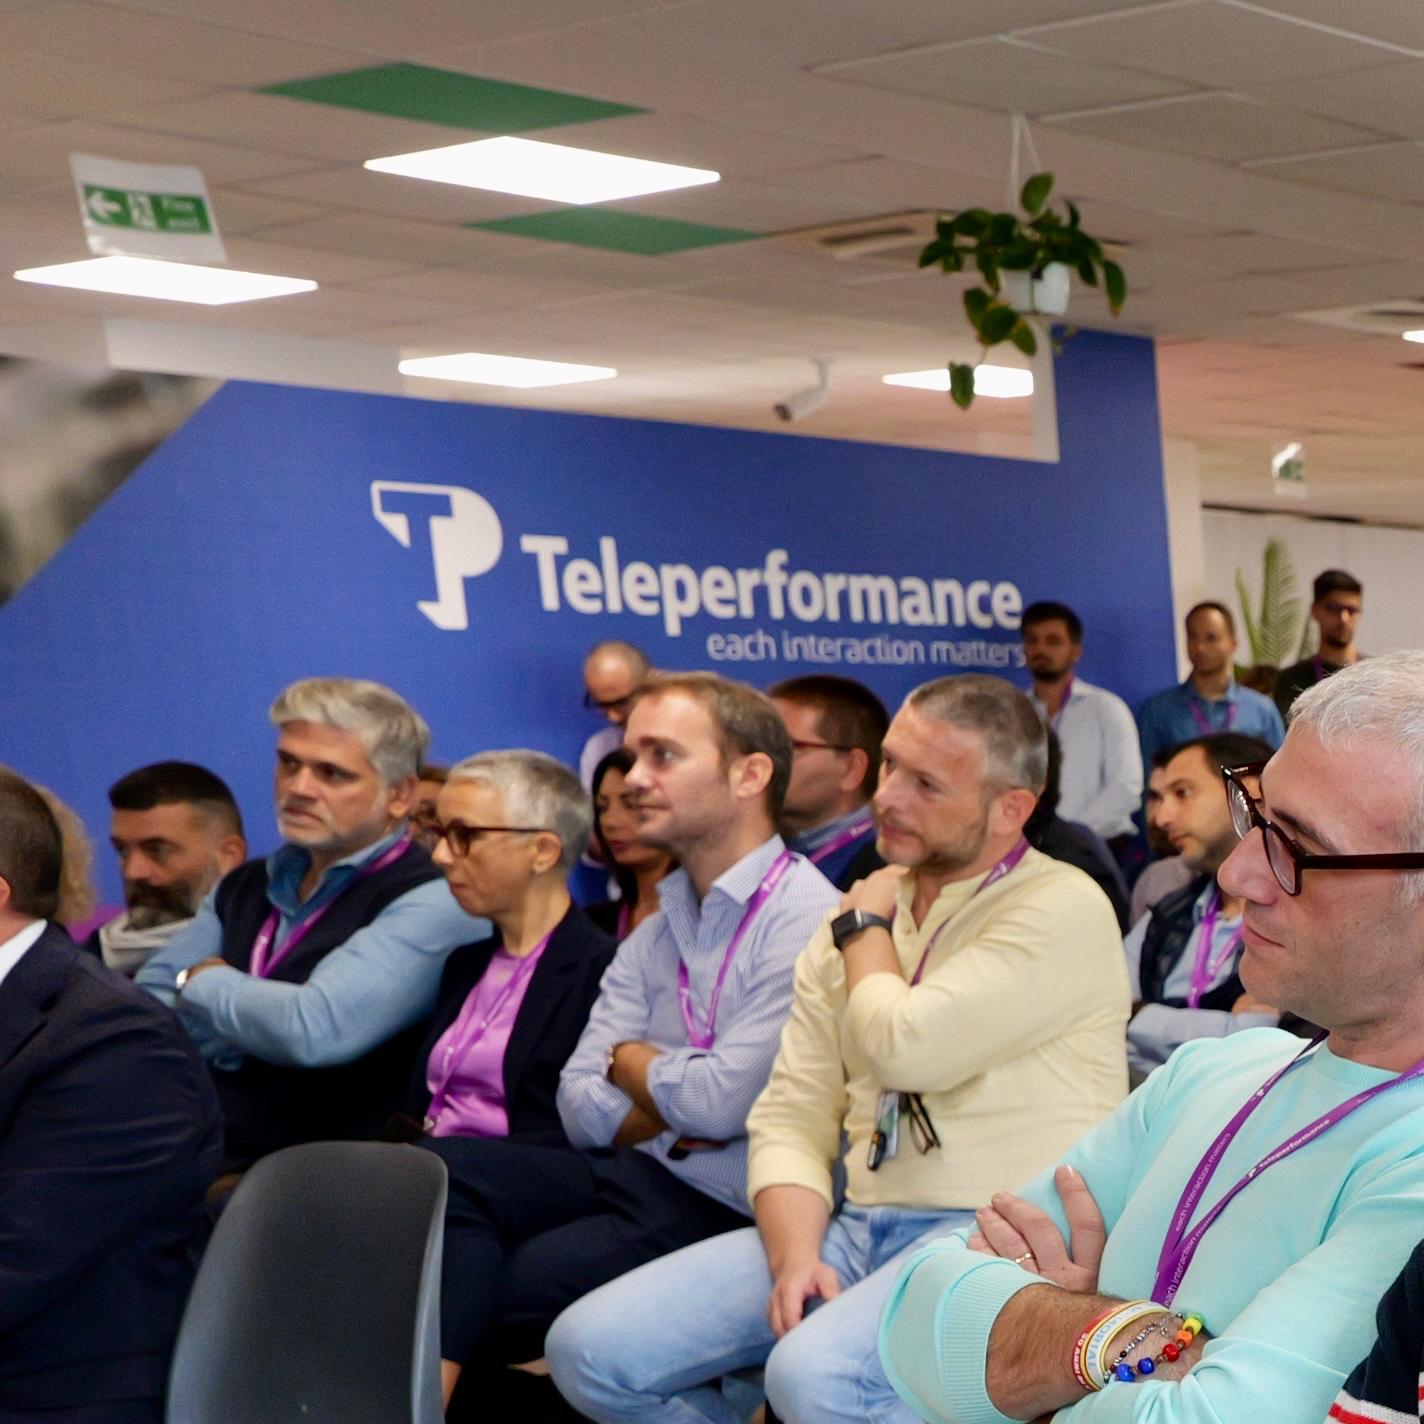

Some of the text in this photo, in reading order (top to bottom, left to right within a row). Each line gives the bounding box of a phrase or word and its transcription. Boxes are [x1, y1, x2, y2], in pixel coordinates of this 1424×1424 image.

[519, 534, 1024, 638] Teleperformance
[706, 628, 1028, 668] each interaction matters
[1259, 1118, 1331, 1168] Teleperformance
[1175, 1206, 1189, 1232] each
[1184, 1162, 1213, 1208] interaction
[1209, 1132, 1231, 1166] matters
[1164, 1236, 1197, 1307] each interaction
